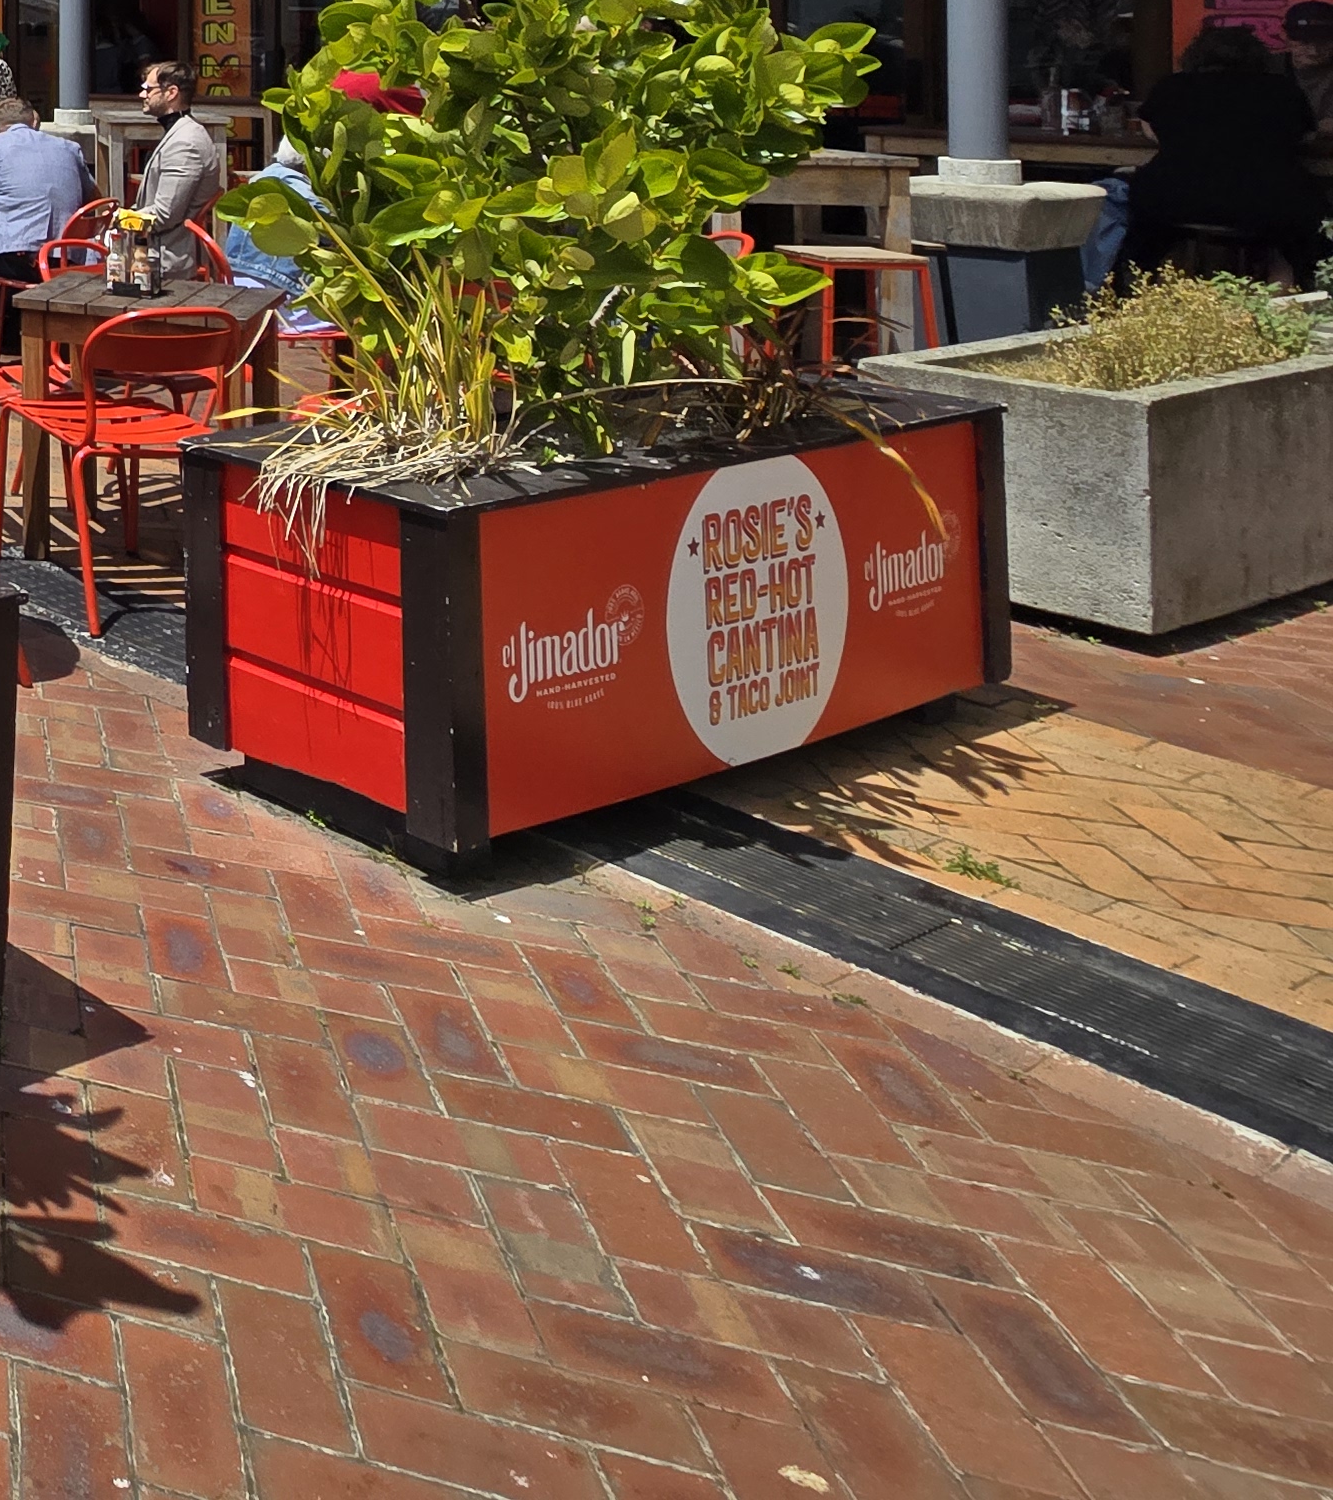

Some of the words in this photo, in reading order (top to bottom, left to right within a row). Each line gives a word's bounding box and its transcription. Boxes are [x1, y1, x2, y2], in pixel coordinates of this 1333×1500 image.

[702, 494, 813, 574] ROSIE'S
[869, 529, 945, 612] Jimador
[705, 554, 815, 630] RED-HOT
[502, 635, 516, 668] el
[508, 607, 625, 703] Jimador
[536, 672, 616, 698] HAND-HARVESTED
[707, 607, 819, 687] CANTINA
[709, 690, 722, 726] &
[726, 676, 770, 721] TACO
[775, 662, 819, 707] JOINT
